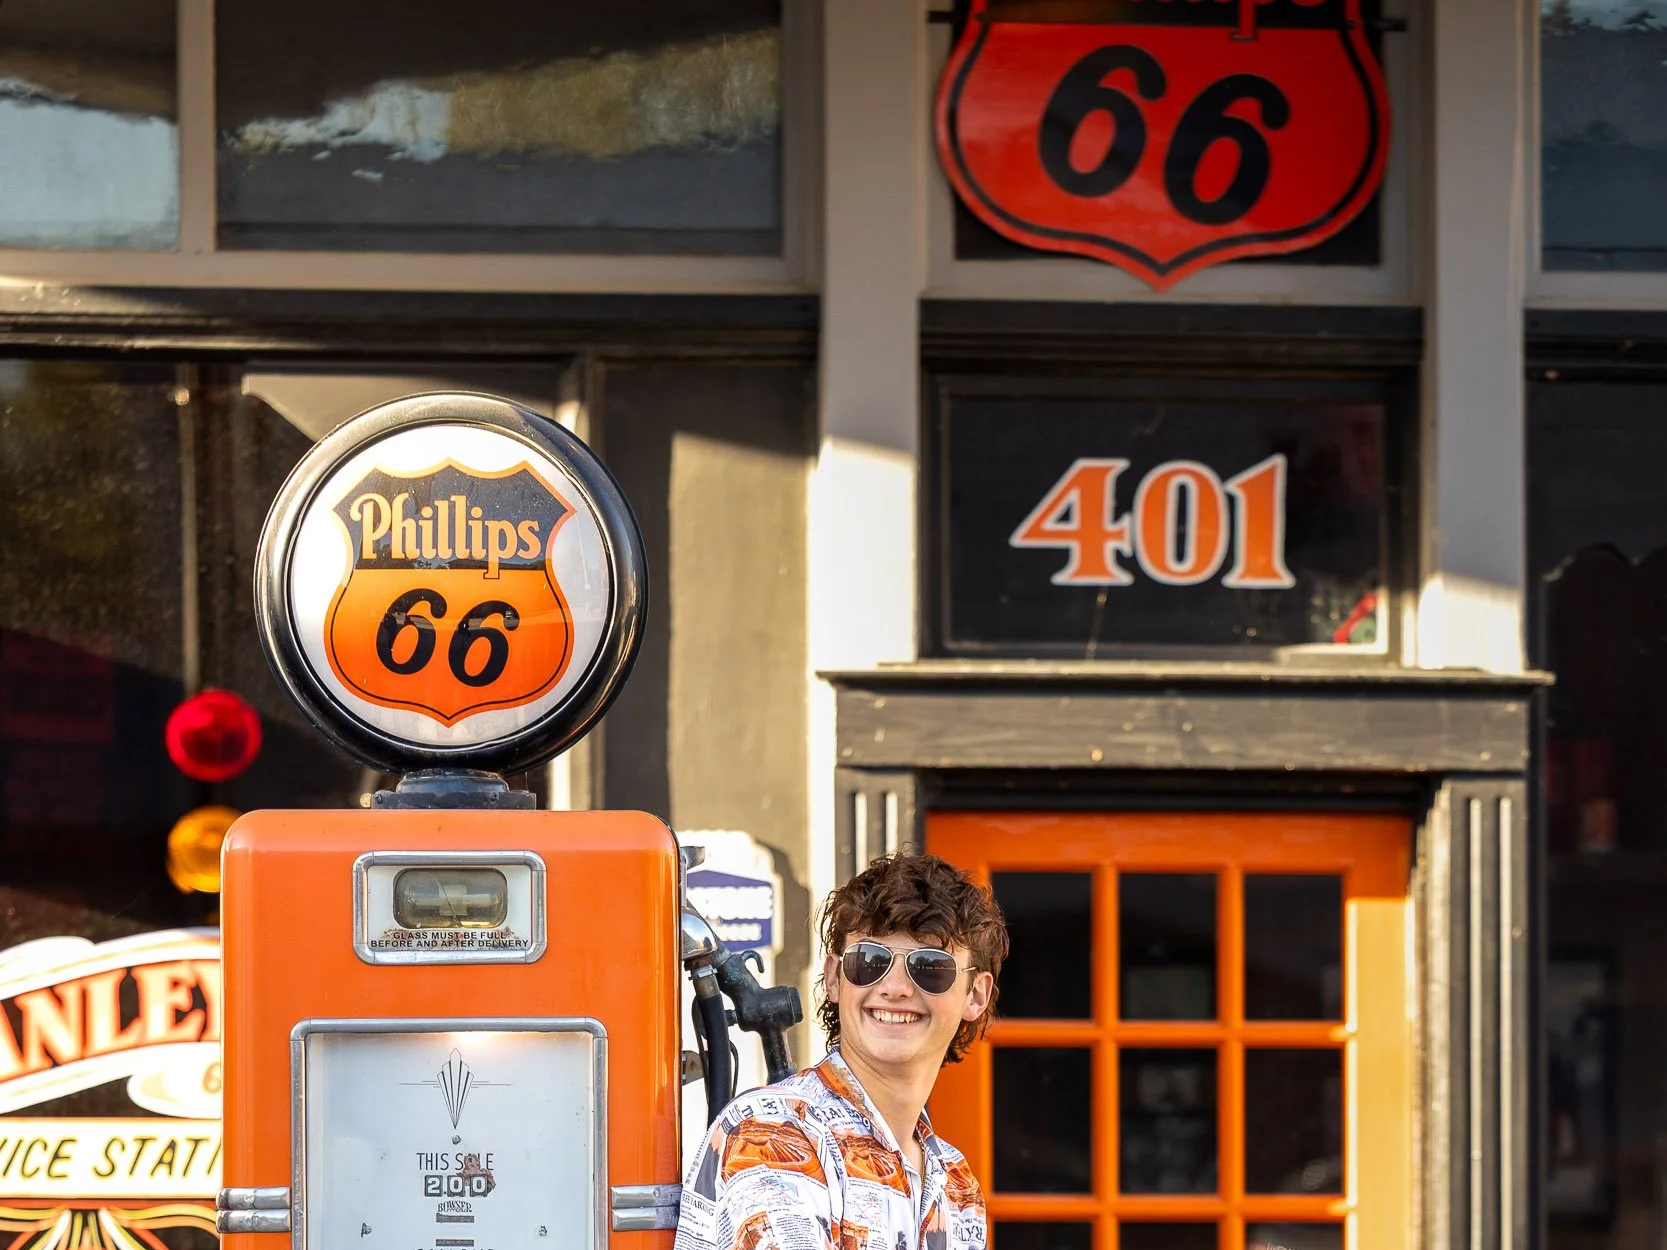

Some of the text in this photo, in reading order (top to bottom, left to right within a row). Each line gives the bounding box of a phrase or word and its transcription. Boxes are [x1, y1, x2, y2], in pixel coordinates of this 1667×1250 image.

[1037, 44, 1292, 227] 66
[350, 493, 542, 580] Phillips
[1009, 454, 1296, 589] 401
[375, 587, 521, 688] 66
[371, 940, 529, 948] BEFORE AND AFTER DELIVERY
[393, 931, 507, 940] GLASS MUST BE FULL
[0, 1138, 76, 1178] ICE
[416, 1152, 494, 1171] THIS SE
